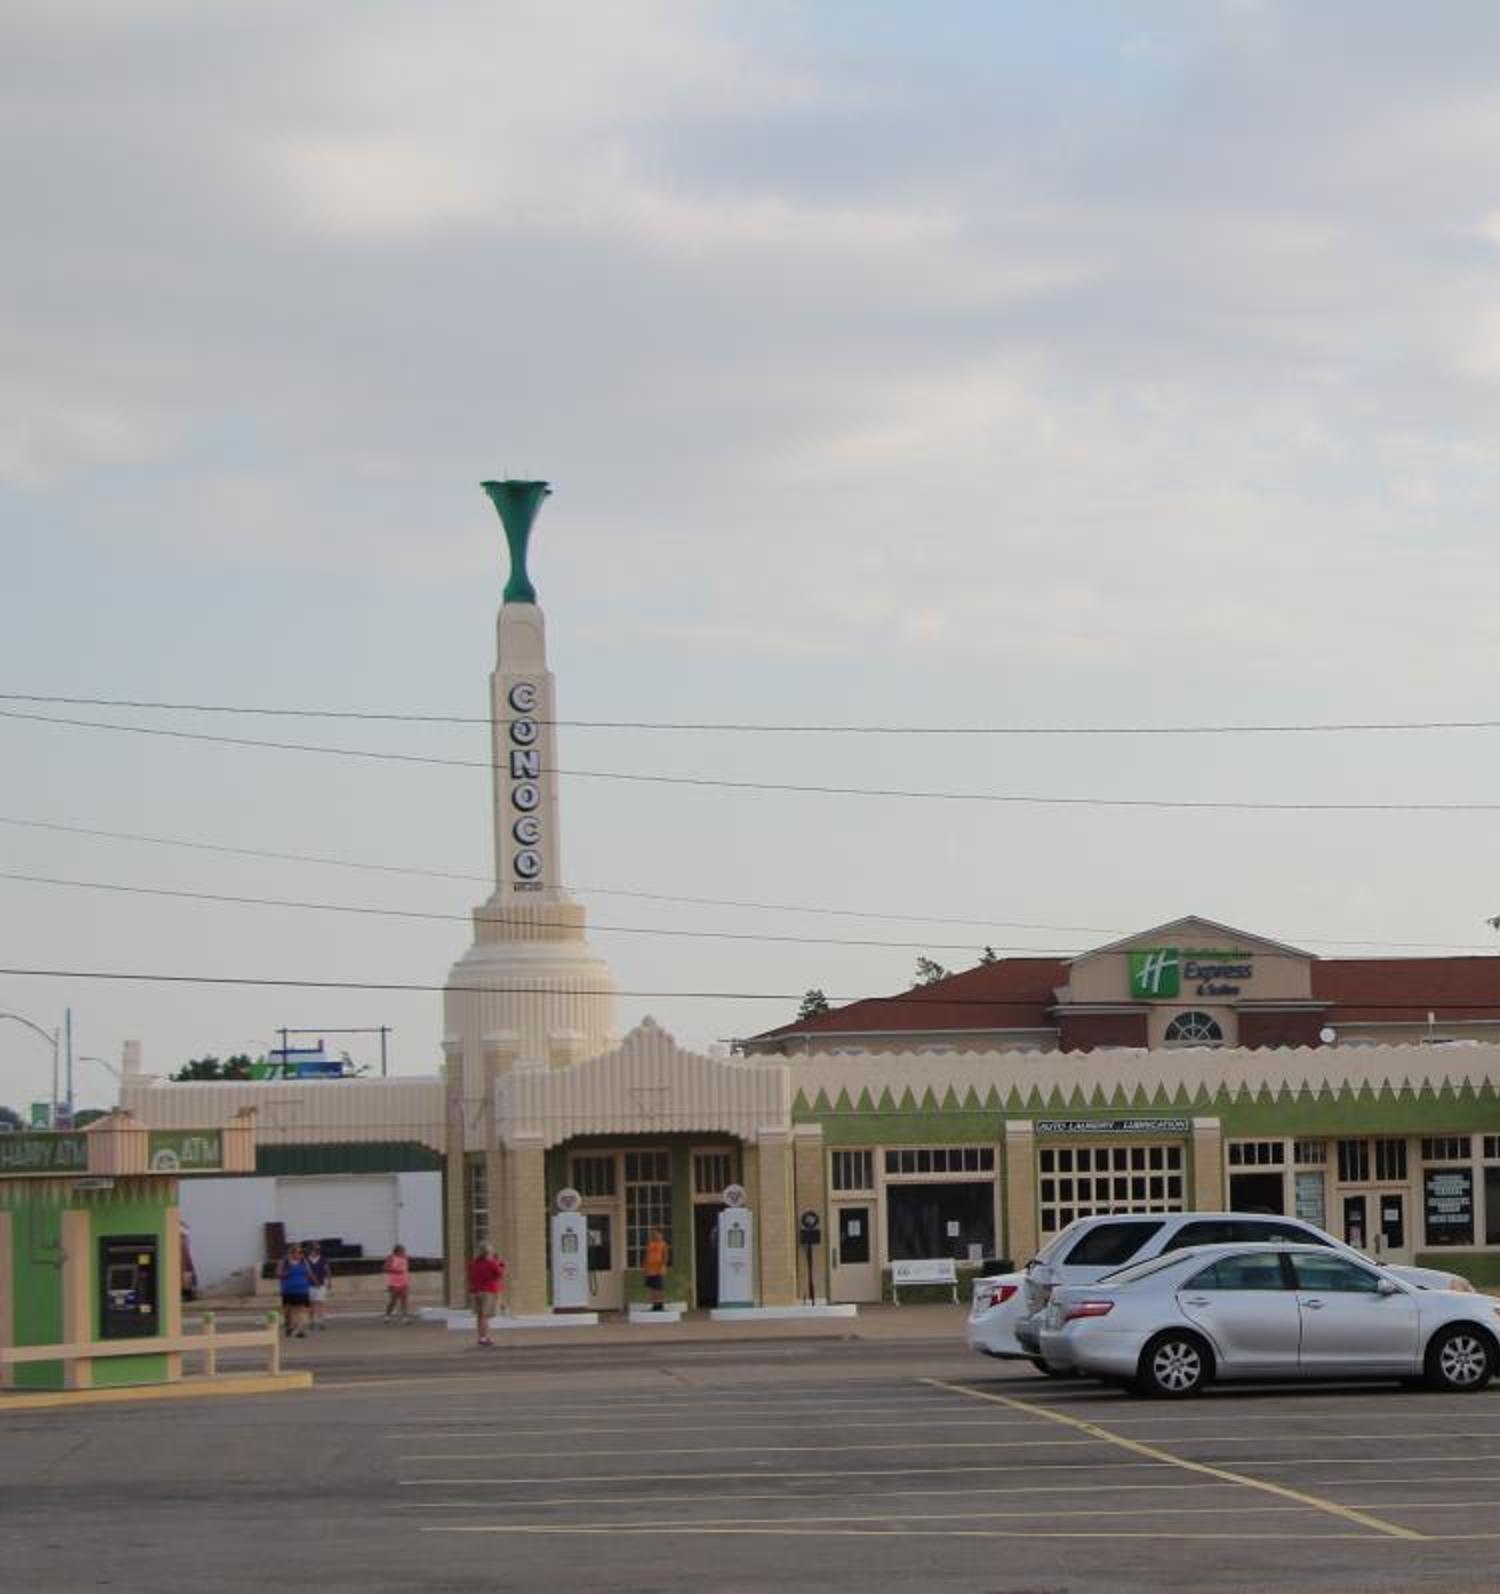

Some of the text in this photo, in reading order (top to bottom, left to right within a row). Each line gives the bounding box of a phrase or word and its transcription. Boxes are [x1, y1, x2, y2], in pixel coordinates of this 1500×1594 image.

[509, 682, 543, 880] CONOCO
[1184, 961, 1252, 983] Express
[181, 1137, 219, 1162] ATM
